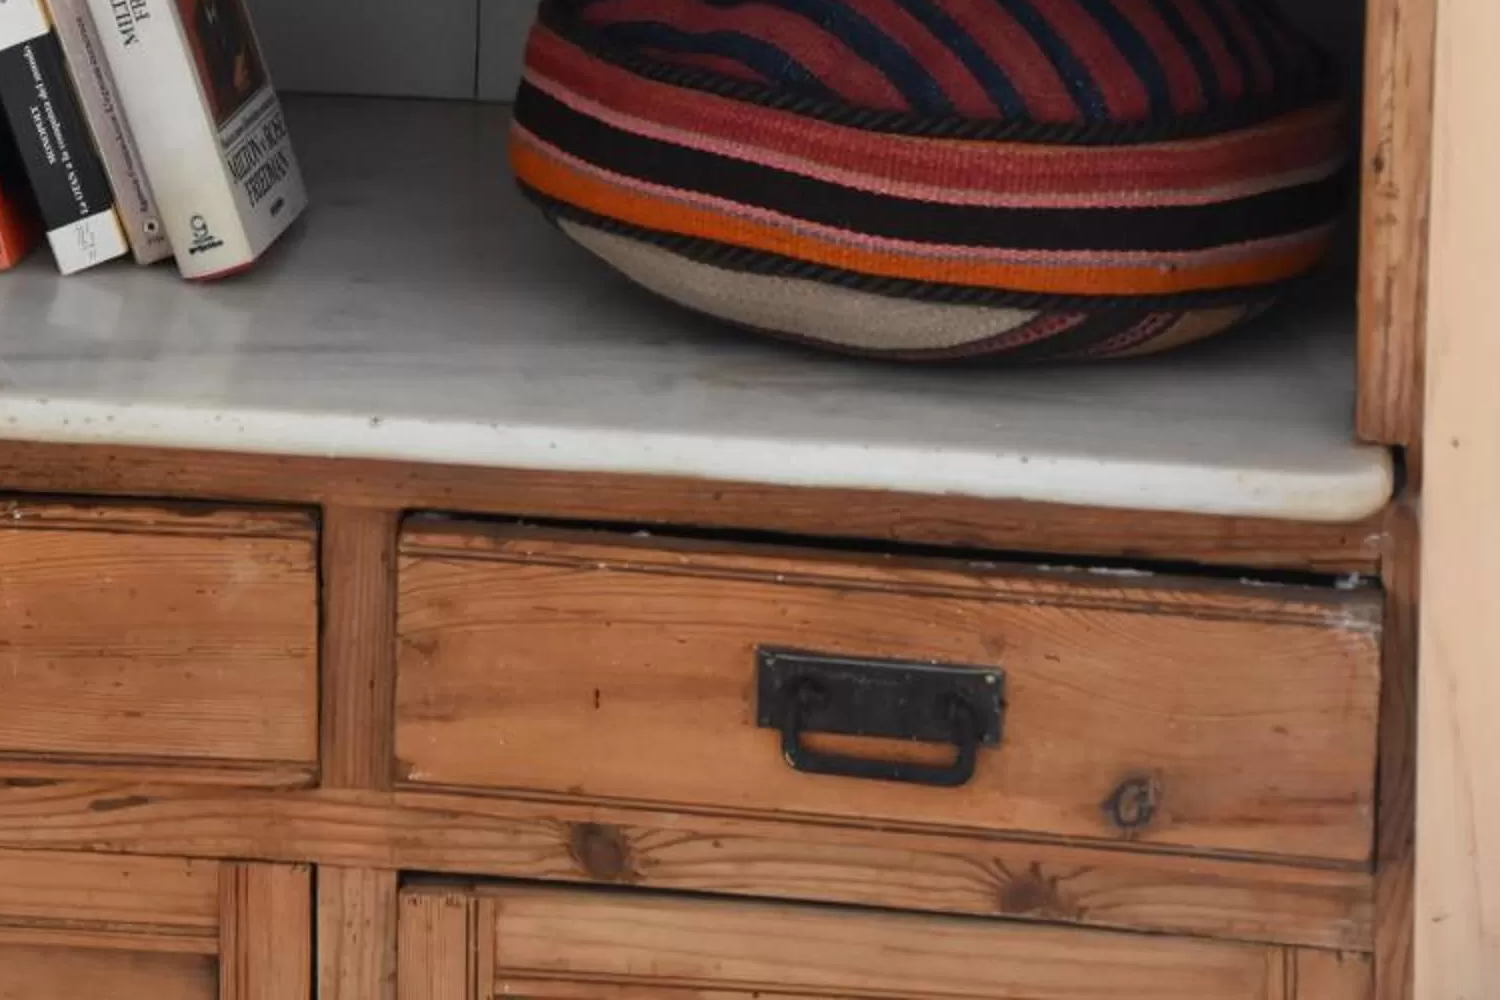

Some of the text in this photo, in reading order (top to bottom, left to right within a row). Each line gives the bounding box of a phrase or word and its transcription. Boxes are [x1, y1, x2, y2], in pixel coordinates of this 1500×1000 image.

[23, 44, 42, 81] mundo
[34, 82, 48, 99] del
[30, 106, 56, 164] MONOPOLY
[43, 100, 65, 149] conquista
[60, 150, 70, 162] la
[67, 170, 83, 200] OTAN
[244, 150, 290, 209] FRIEDMAN
[79, 200, 88, 214] La
